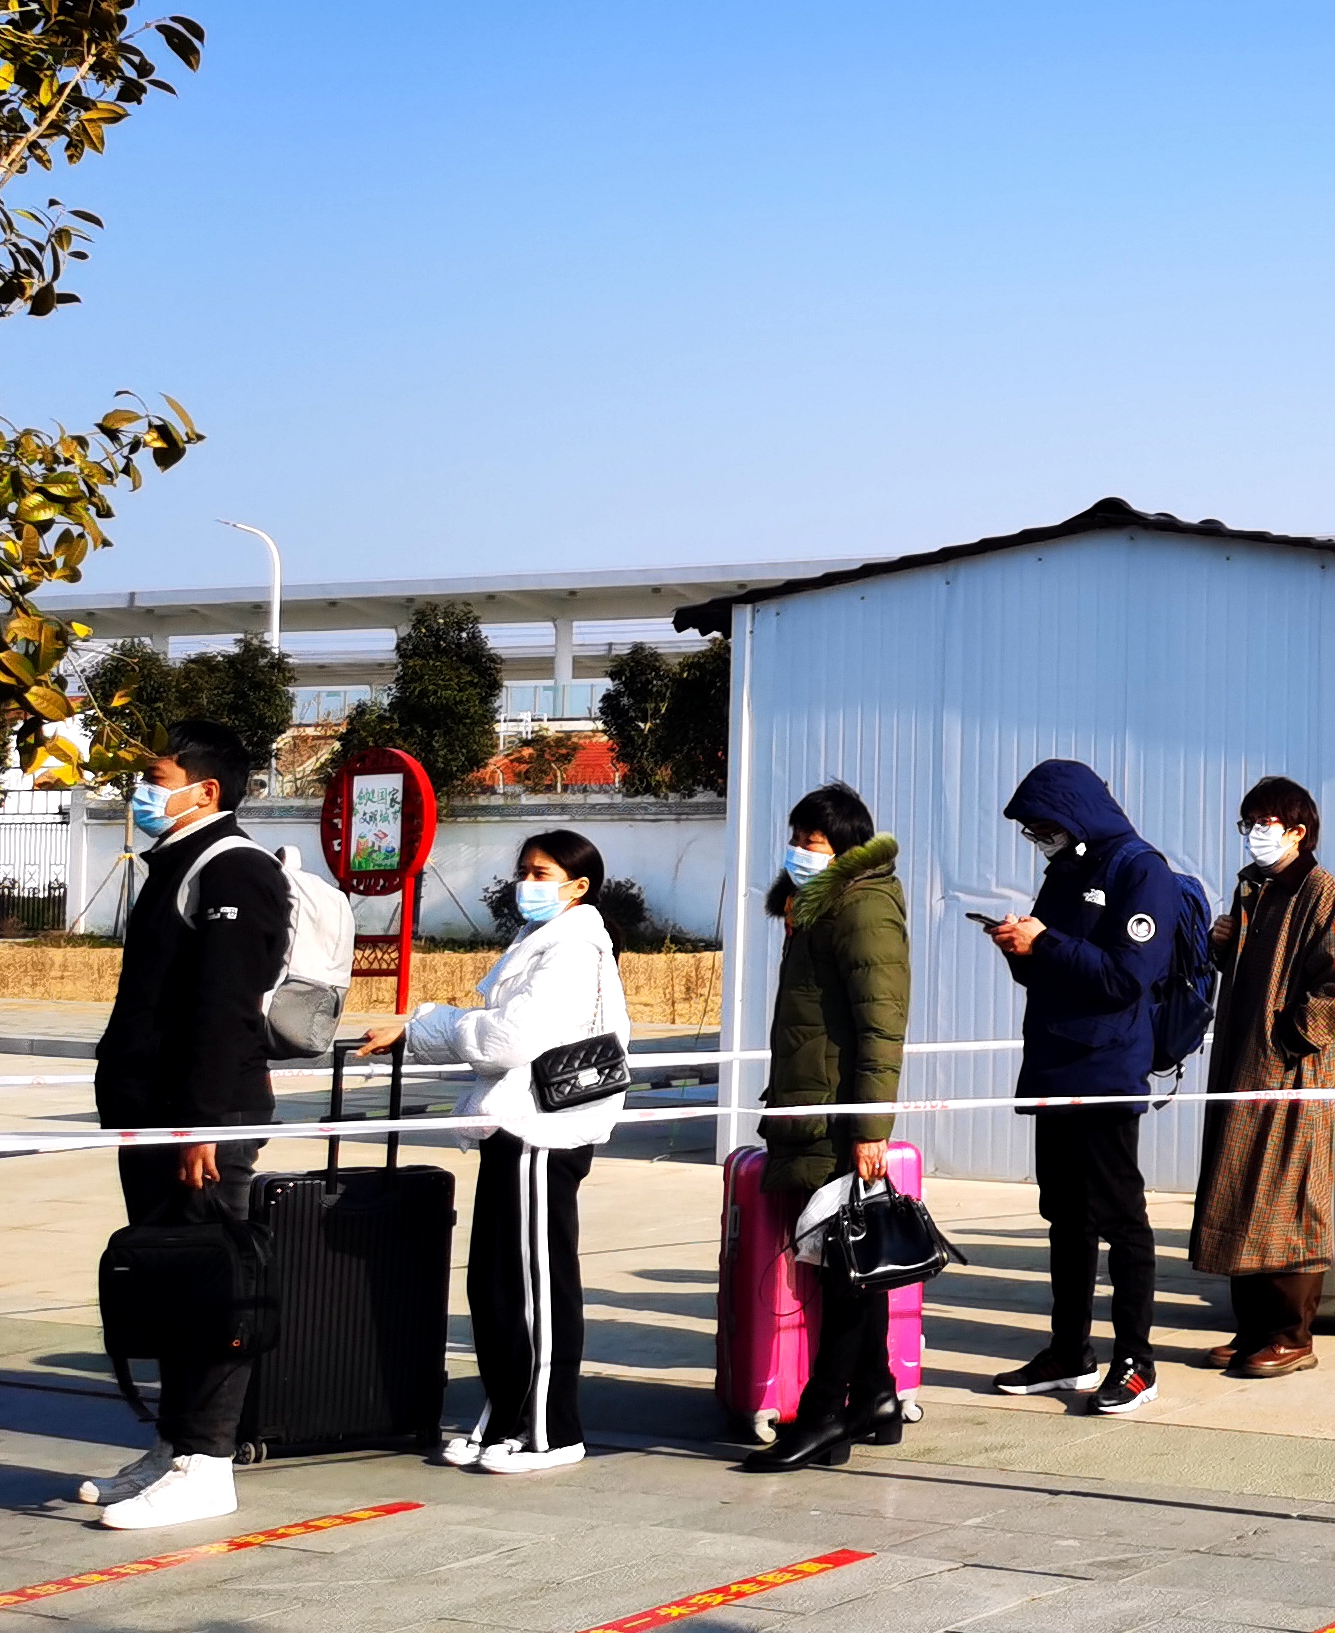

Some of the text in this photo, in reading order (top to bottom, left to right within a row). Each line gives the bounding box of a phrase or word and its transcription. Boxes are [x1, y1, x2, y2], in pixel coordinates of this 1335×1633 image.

[589, 1561, 835, 1633] 一米安全距离
